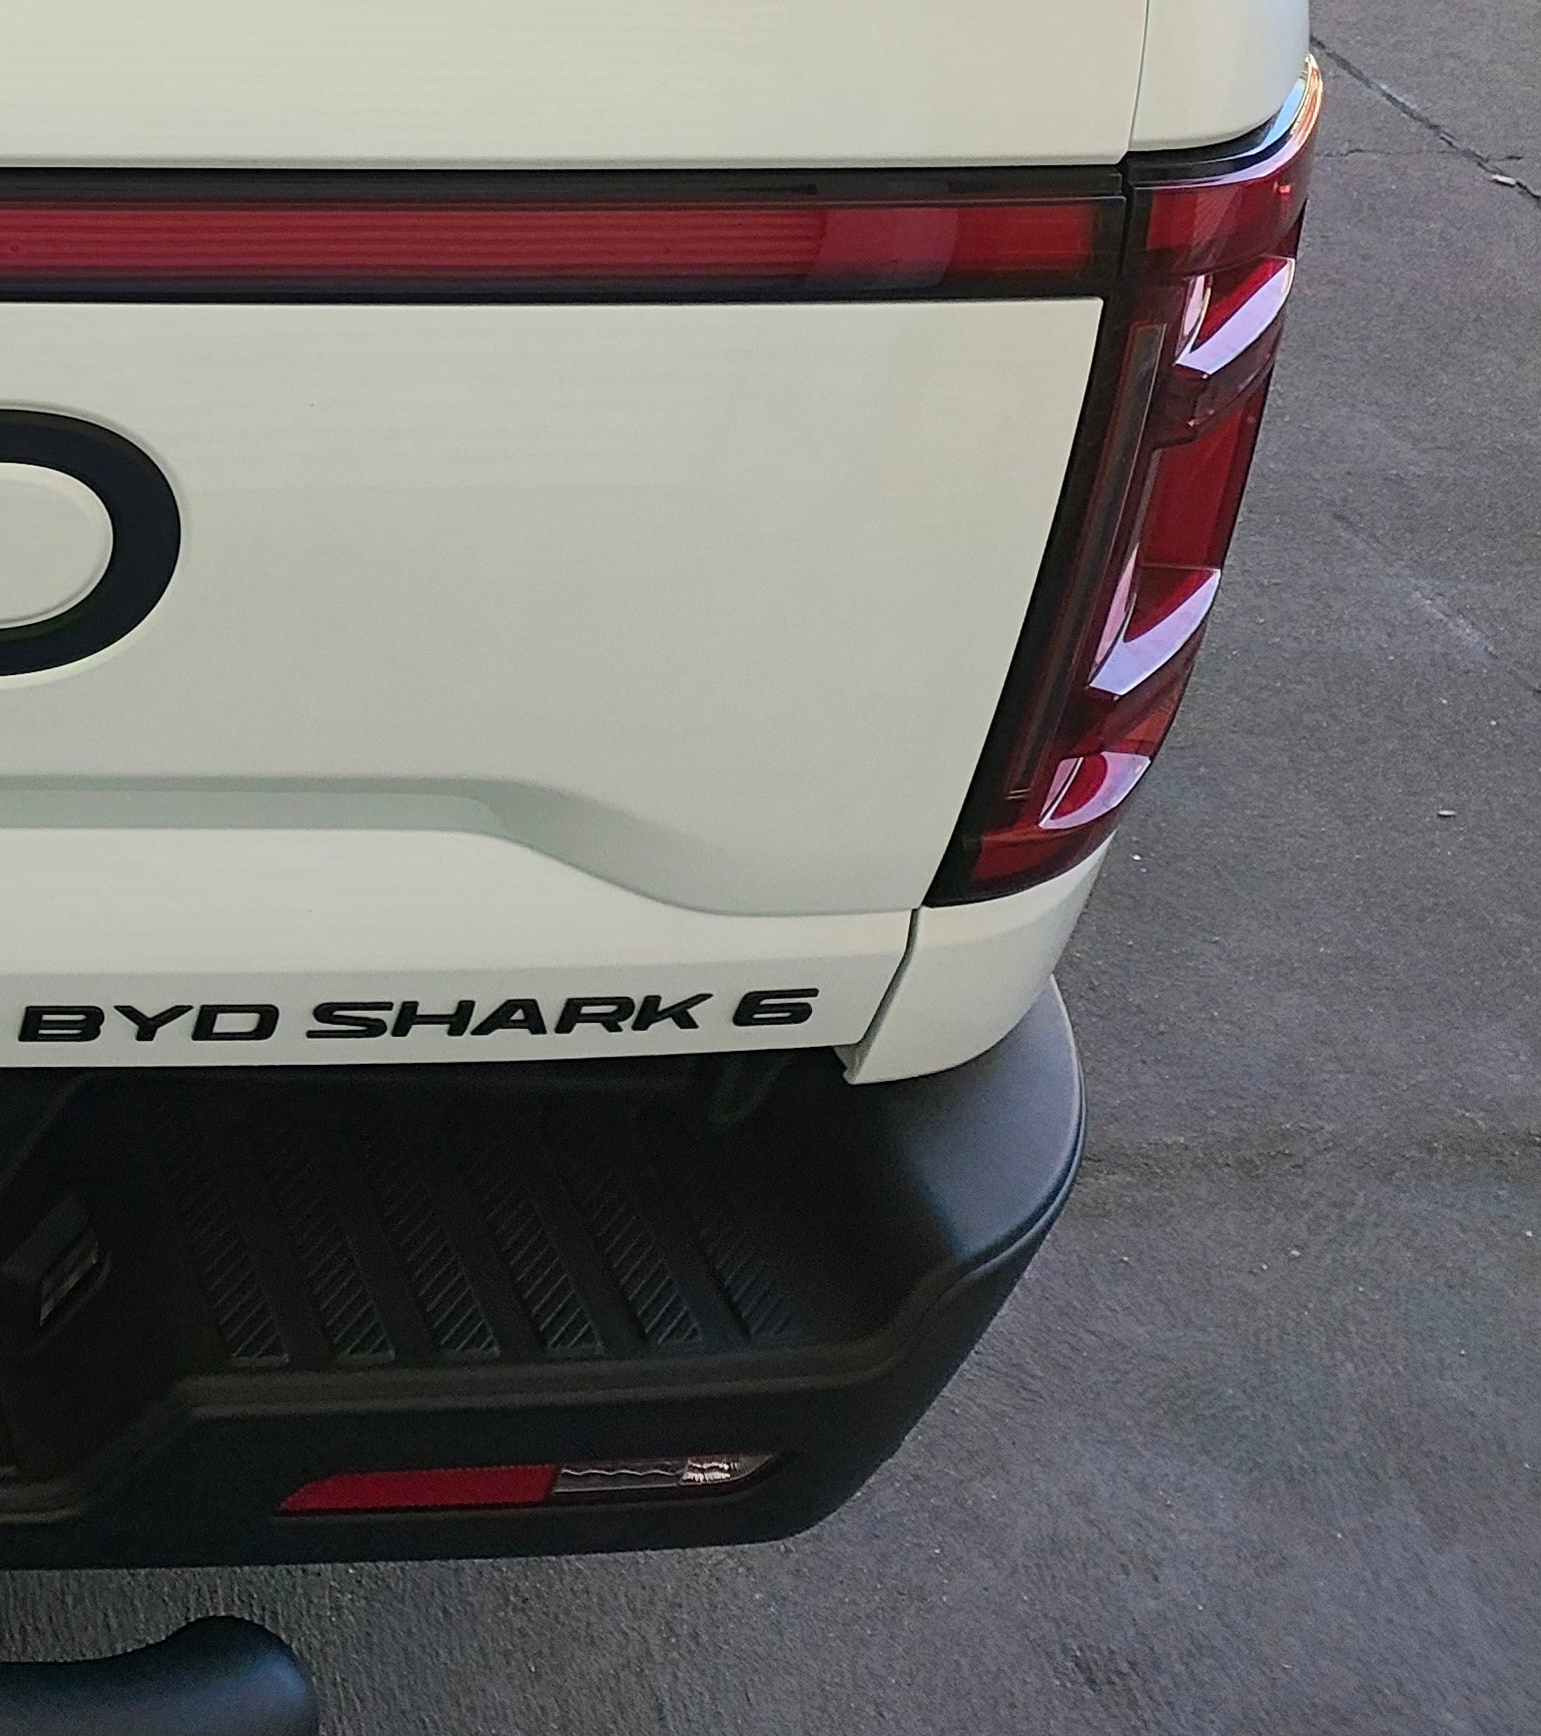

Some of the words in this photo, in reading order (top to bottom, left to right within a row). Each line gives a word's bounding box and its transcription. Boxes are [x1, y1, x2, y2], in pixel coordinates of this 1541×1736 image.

[17, 1004, 280, 1043] BYD
[305, 993, 715, 1040] SHARK
[731, 987, 821, 1028] 6
